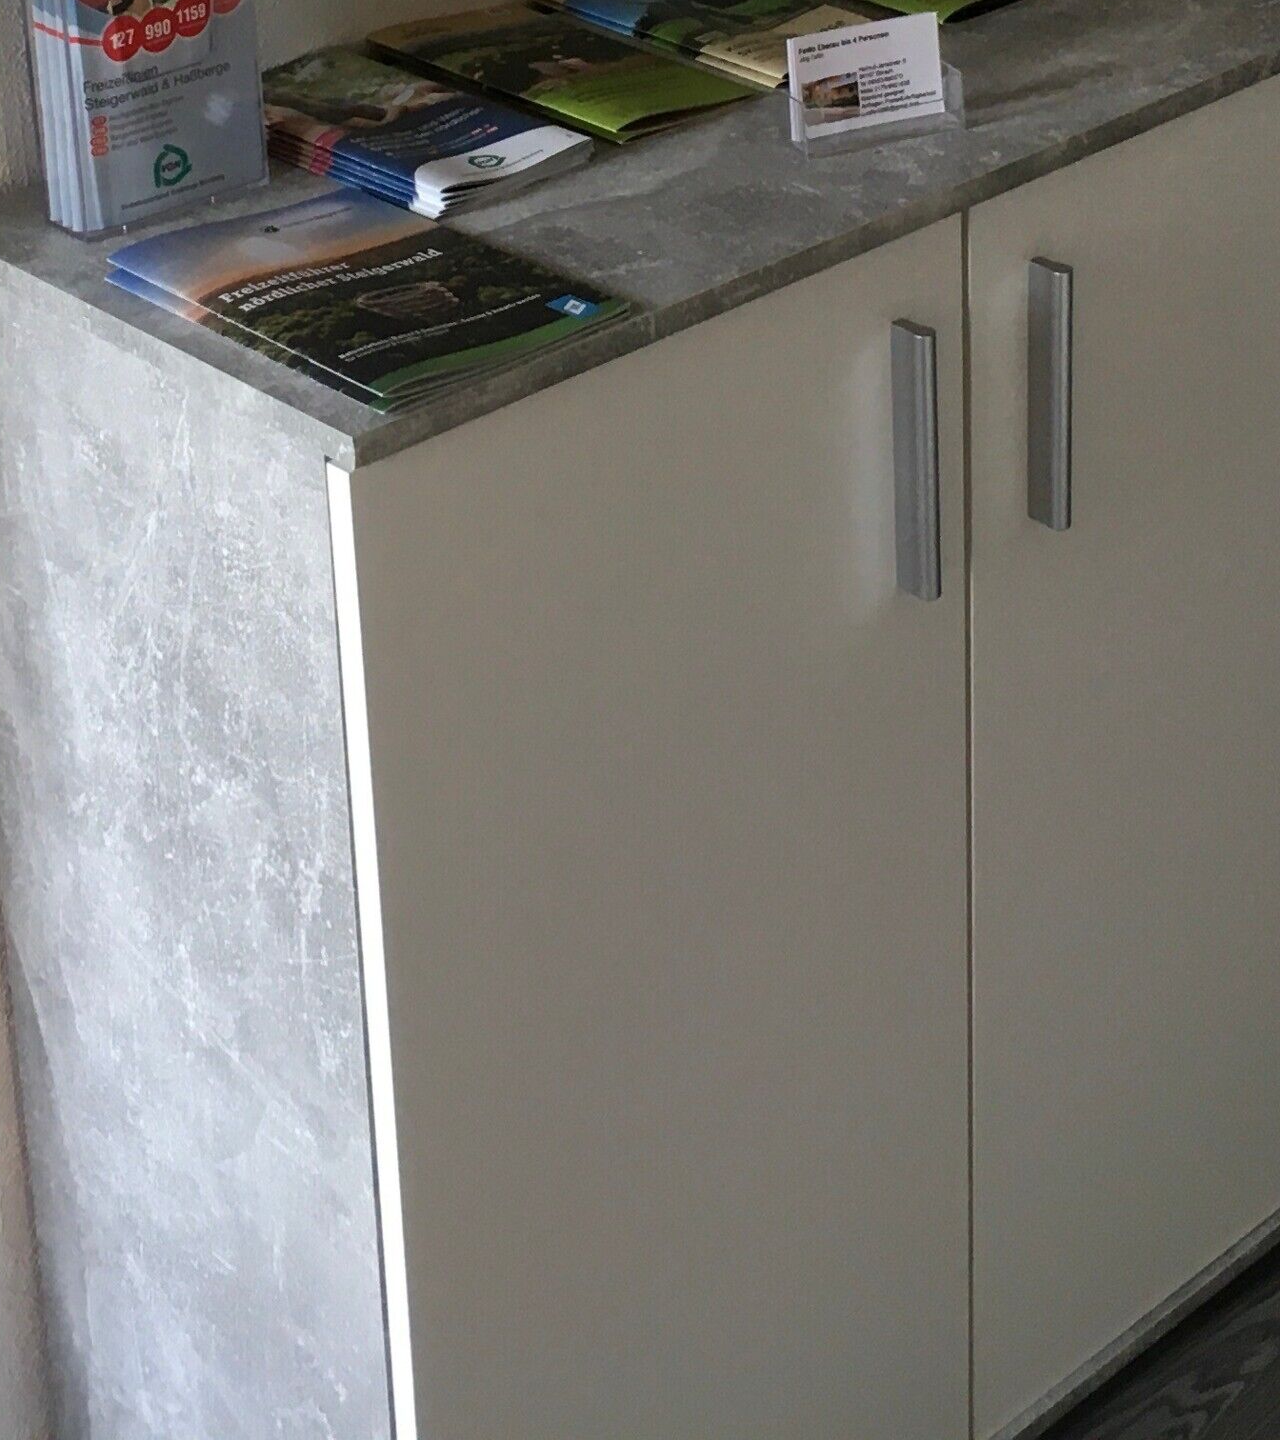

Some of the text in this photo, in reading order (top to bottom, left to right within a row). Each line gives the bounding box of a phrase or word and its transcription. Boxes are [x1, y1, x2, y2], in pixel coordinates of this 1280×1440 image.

[176, 3, 207, 24] 1159
[109, 29, 136, 51] 127
[145, 19, 171, 41] 990
[84, 81, 160, 112] Steigerwald
[217, 260, 351, 304] Freizeitführer
[237, 247, 444, 314] nördlicher Steigerwald
